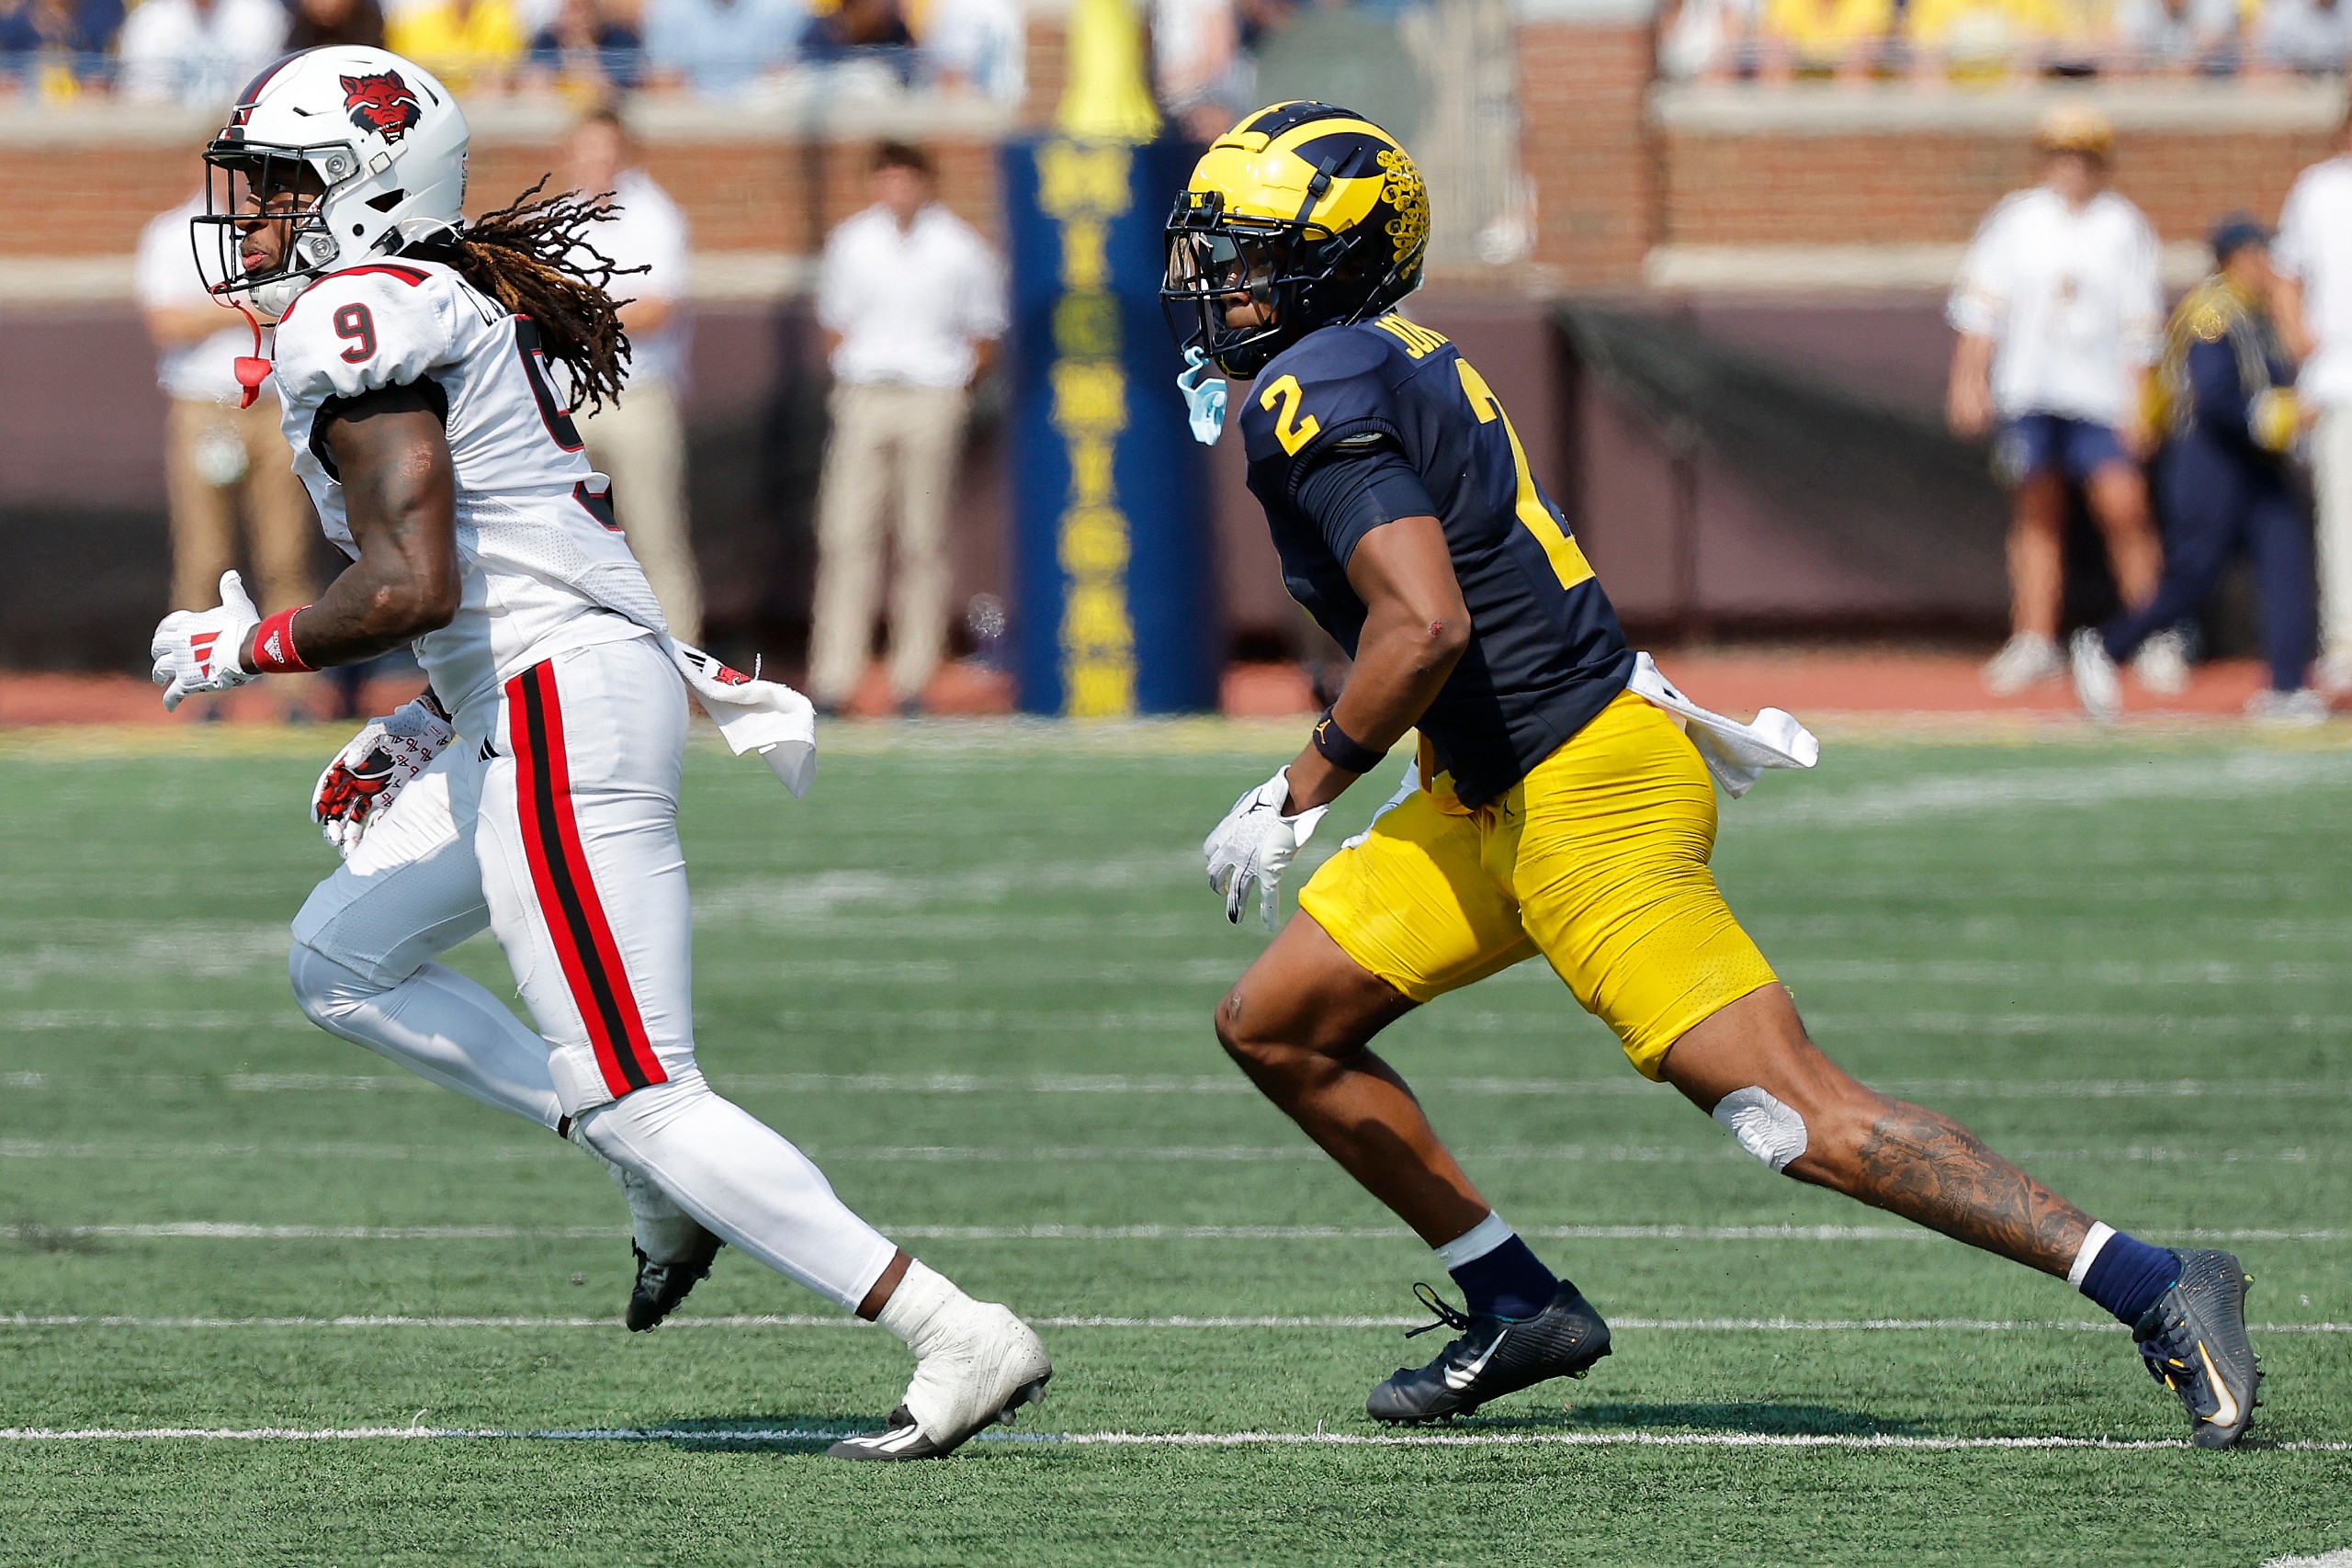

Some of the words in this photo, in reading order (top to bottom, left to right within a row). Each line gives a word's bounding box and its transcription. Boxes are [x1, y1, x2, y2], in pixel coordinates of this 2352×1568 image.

[333, 302, 377, 364] 9
[1260, 374, 1321, 457] 2
[1454, 357, 1596, 591] 2
[273, 629, 285, 664] adidas
